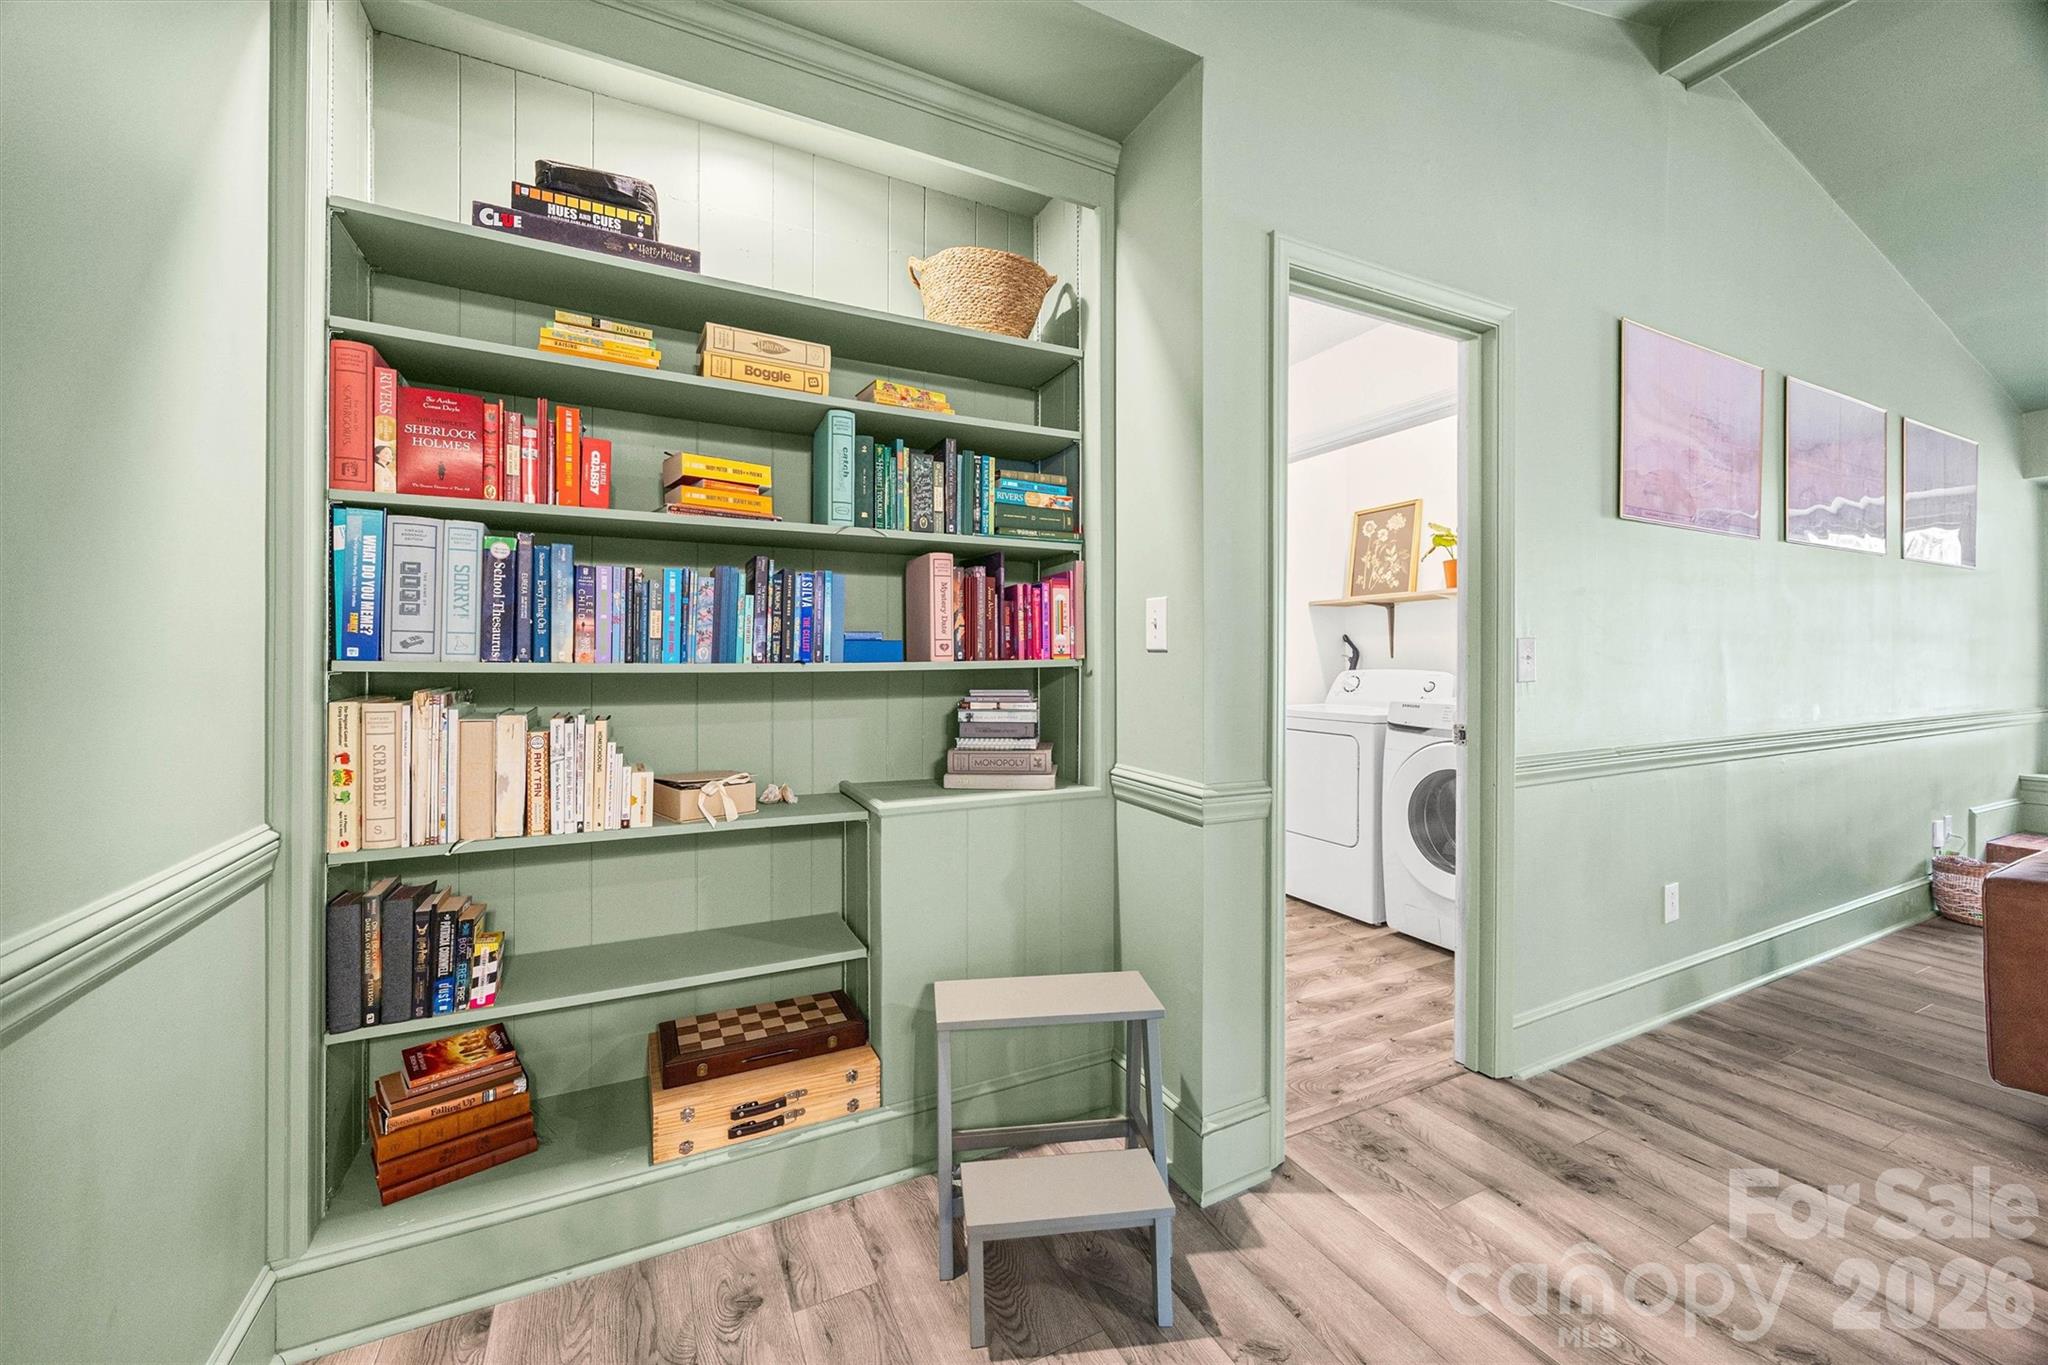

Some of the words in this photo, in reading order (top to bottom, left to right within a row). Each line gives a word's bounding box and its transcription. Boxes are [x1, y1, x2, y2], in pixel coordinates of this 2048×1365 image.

[479, 207, 522, 228] CLUE
[547, 203, 577, 220] HUES
[579, 213, 591, 221] AND
[592, 213, 621, 230] CUES
[639, 244, 660, 259] Harry
[660, 247, 683, 263] Potter
[615, 325, 646, 337] HOBBIT
[554, 341, 578, 350] RAISING
[744, 365, 791, 382] Boggle
[379, 371, 393, 414] RIVERS
[436, 397, 457, 405] Arthur
[442, 404, 460, 412] Doyle
[404, 424, 477, 440] SHERLOCK
[412, 437, 471, 451] HOLMES
[842, 446, 850, 478] catch
[590, 450, 601, 495] CRABBY
[996, 492, 1024, 501] RIVERS
[363, 535, 377, 564] WHAT
[361, 565, 375, 579] DO
[493, 562, 506, 598] School
[360, 580, 374, 603] YOU
[399, 561, 421, 616] LIFE
[453, 564, 470, 619] SORRY!
[536, 580, 546, 599] Every
[802, 582, 813, 608] SILVA
[940, 582, 949, 614] Mystery
[537, 599, 546, 617] Thing
[578, 589, 586, 619] CHILD
[586, 595, 594, 615] LEE
[359, 603, 374, 636] MEME?
[491, 600, 505, 657] Thesaurus
[538, 618, 546, 629] On
[534, 752, 542, 777] AMY
[974, 758, 1025, 767] MONOPOLY
[373, 744, 386, 807] SCRABBLE
[534, 778, 542, 797] TAN
[374, 825, 383, 834] S
[440, 921, 451, 946] PATRICIA
[458, 937, 467, 954] BOX
[437, 946, 450, 977] CORNWELL
[457, 963, 467, 985] FREE
[367, 979, 375, 1007] PETERSON
[438, 982, 452, 1002] dust
[456, 986, 465, 1003] FIRE
[430, 1102, 462, 1117] Falling
[463, 1097, 476, 1108] Up
